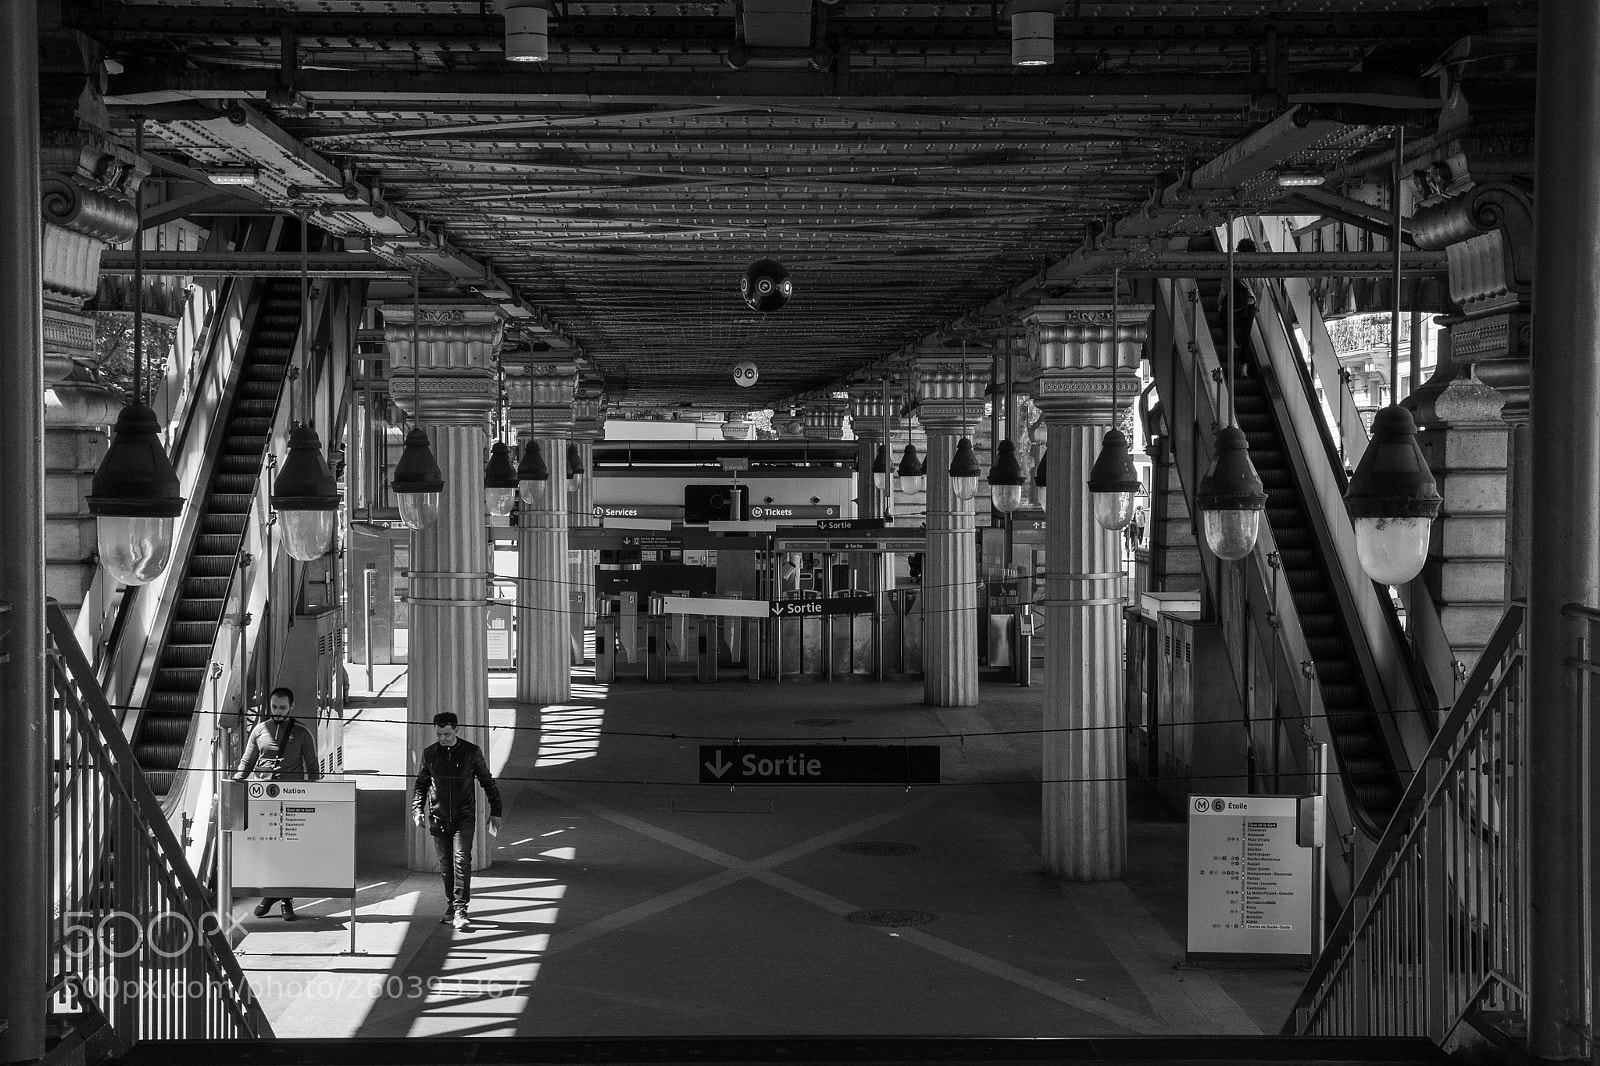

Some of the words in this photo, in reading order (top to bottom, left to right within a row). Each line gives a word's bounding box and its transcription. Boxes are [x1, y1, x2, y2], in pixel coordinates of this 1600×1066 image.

[605, 508, 638, 516] Services
[765, 508, 793, 516] Tickets
[828, 521, 852, 529] Sortie
[787, 602, 823, 614] Sortie
[742, 753, 822, 777] Sortie
